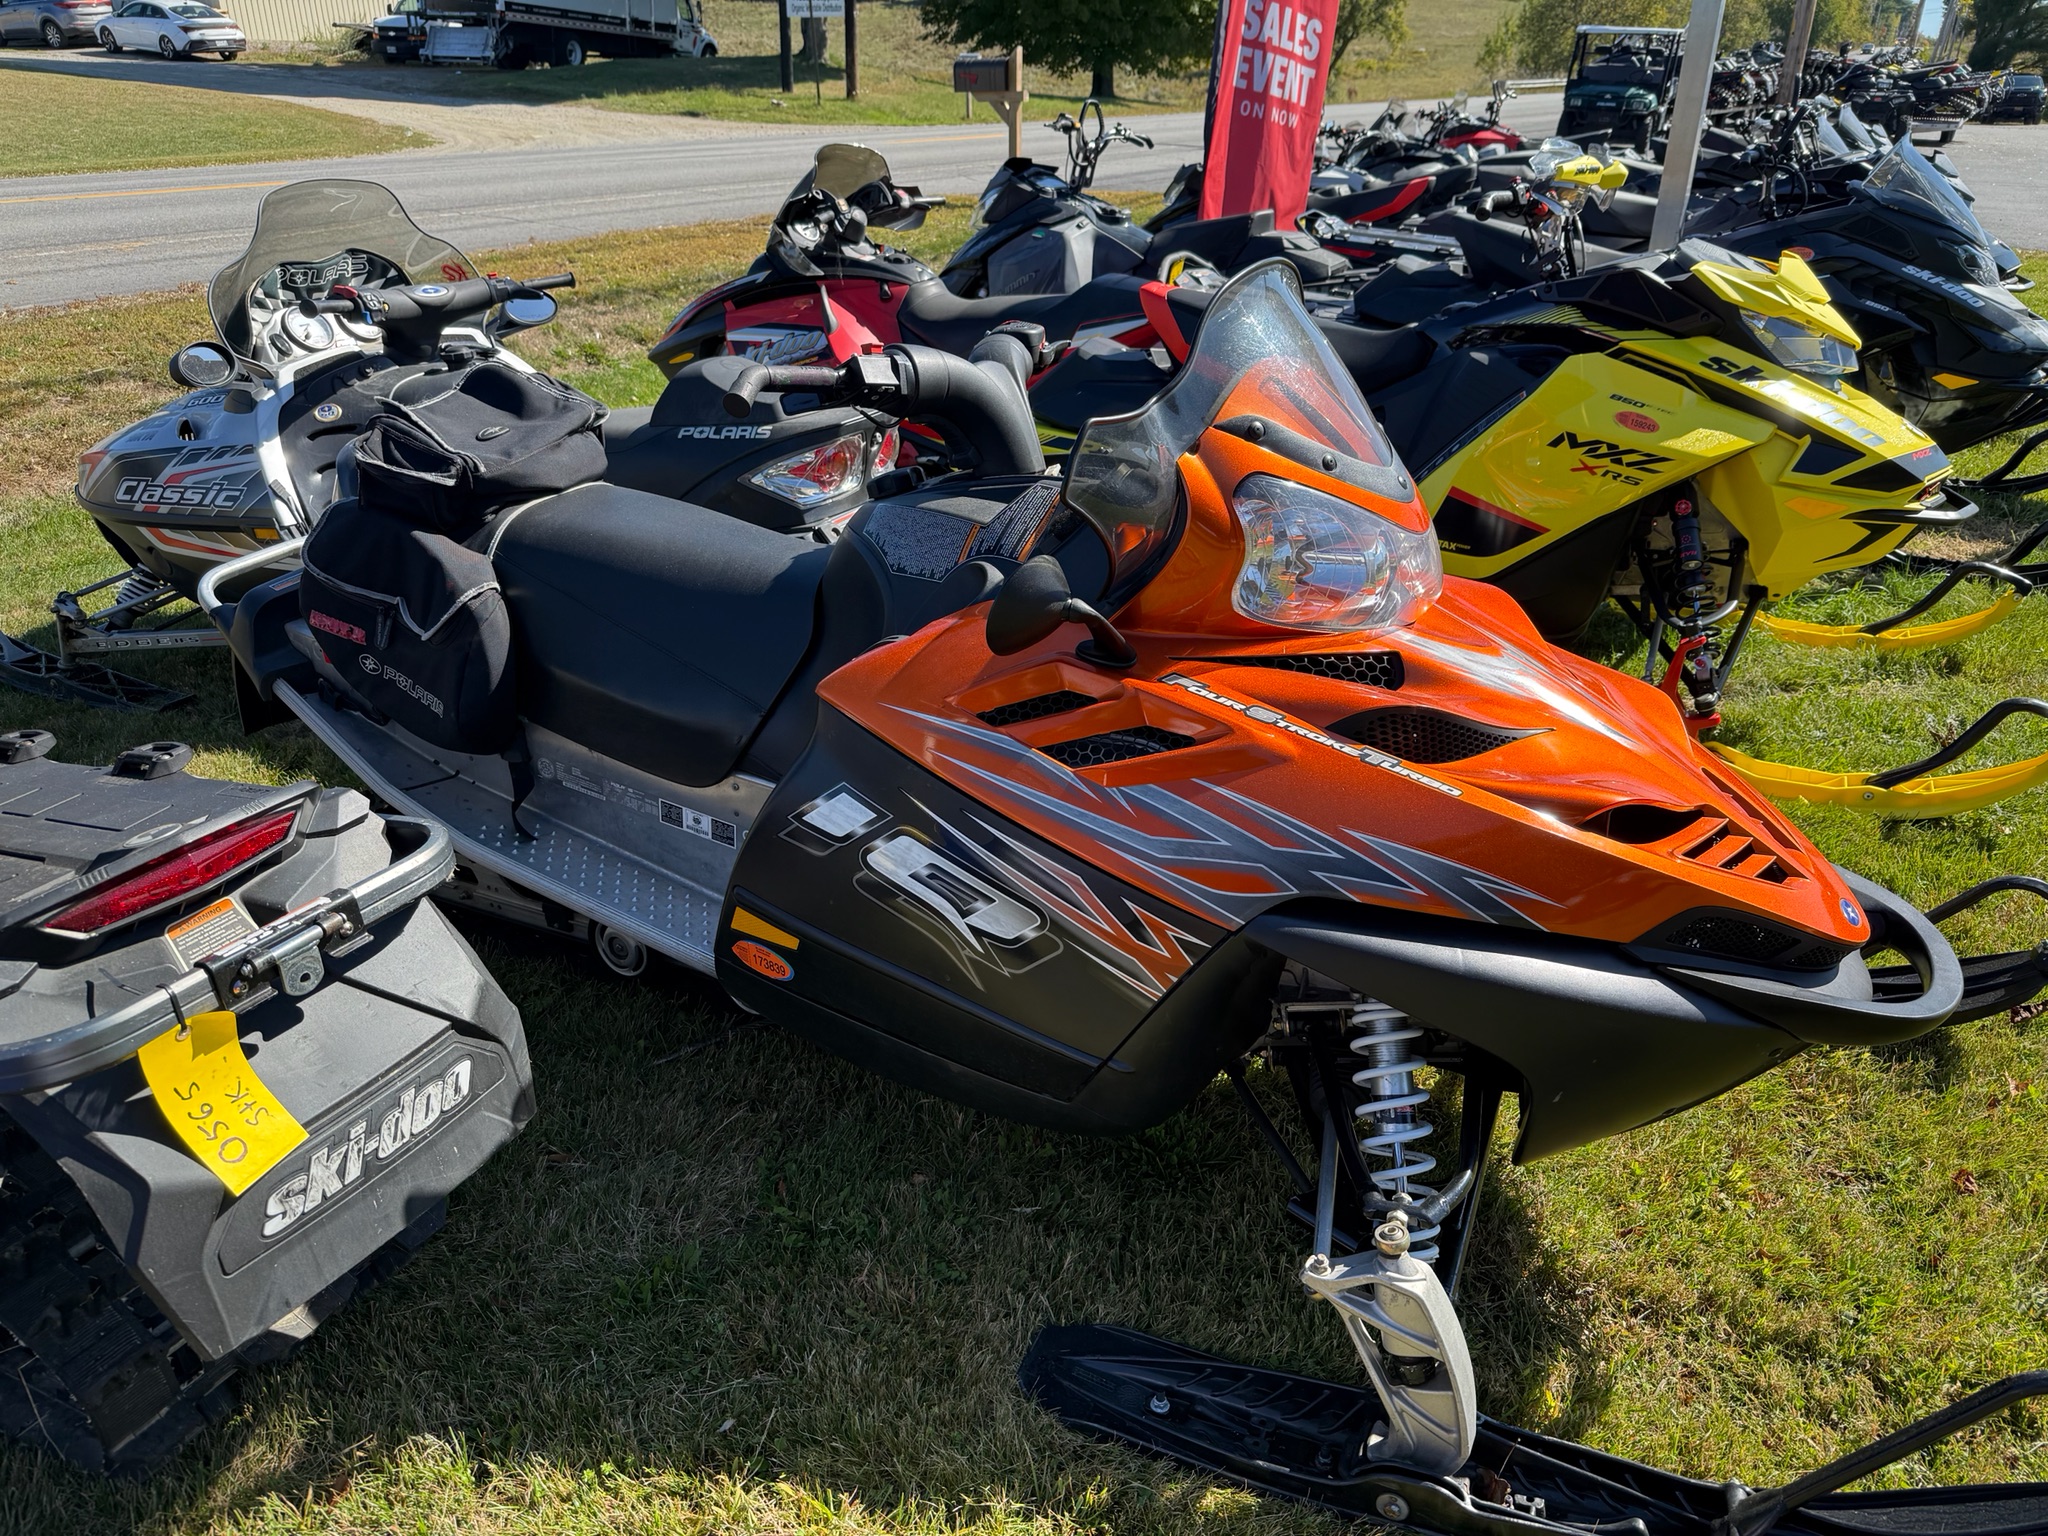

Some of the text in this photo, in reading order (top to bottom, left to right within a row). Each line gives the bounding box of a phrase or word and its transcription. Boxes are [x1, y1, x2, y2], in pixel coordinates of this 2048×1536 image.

[1242, 0, 1323, 60] SALES
[1233, 45, 1316, 107] EVENT
[1240, 100, 1299, 129] ON NOW
[275, 253, 369, 287] POLARS
[743, 330, 823, 363] ki-doo
[186, 394, 226, 407] 600
[1609, 393, 1646, 409] 850
[678, 426, 773, 439] POLARIS
[1630, 418, 1656, 432] 159243
[1546, 431, 1676, 474] MXZ
[114, 476, 247, 511] Classic
[1438, 540, 1457, 550] TAX
[96, 637, 172, 650] EDGE
[383, 665, 444, 718] POLARIS
[184, 906, 222, 929] WARNING
[753, 954, 786, 976] 173839
[261, 1059, 472, 1237] ski-doo
